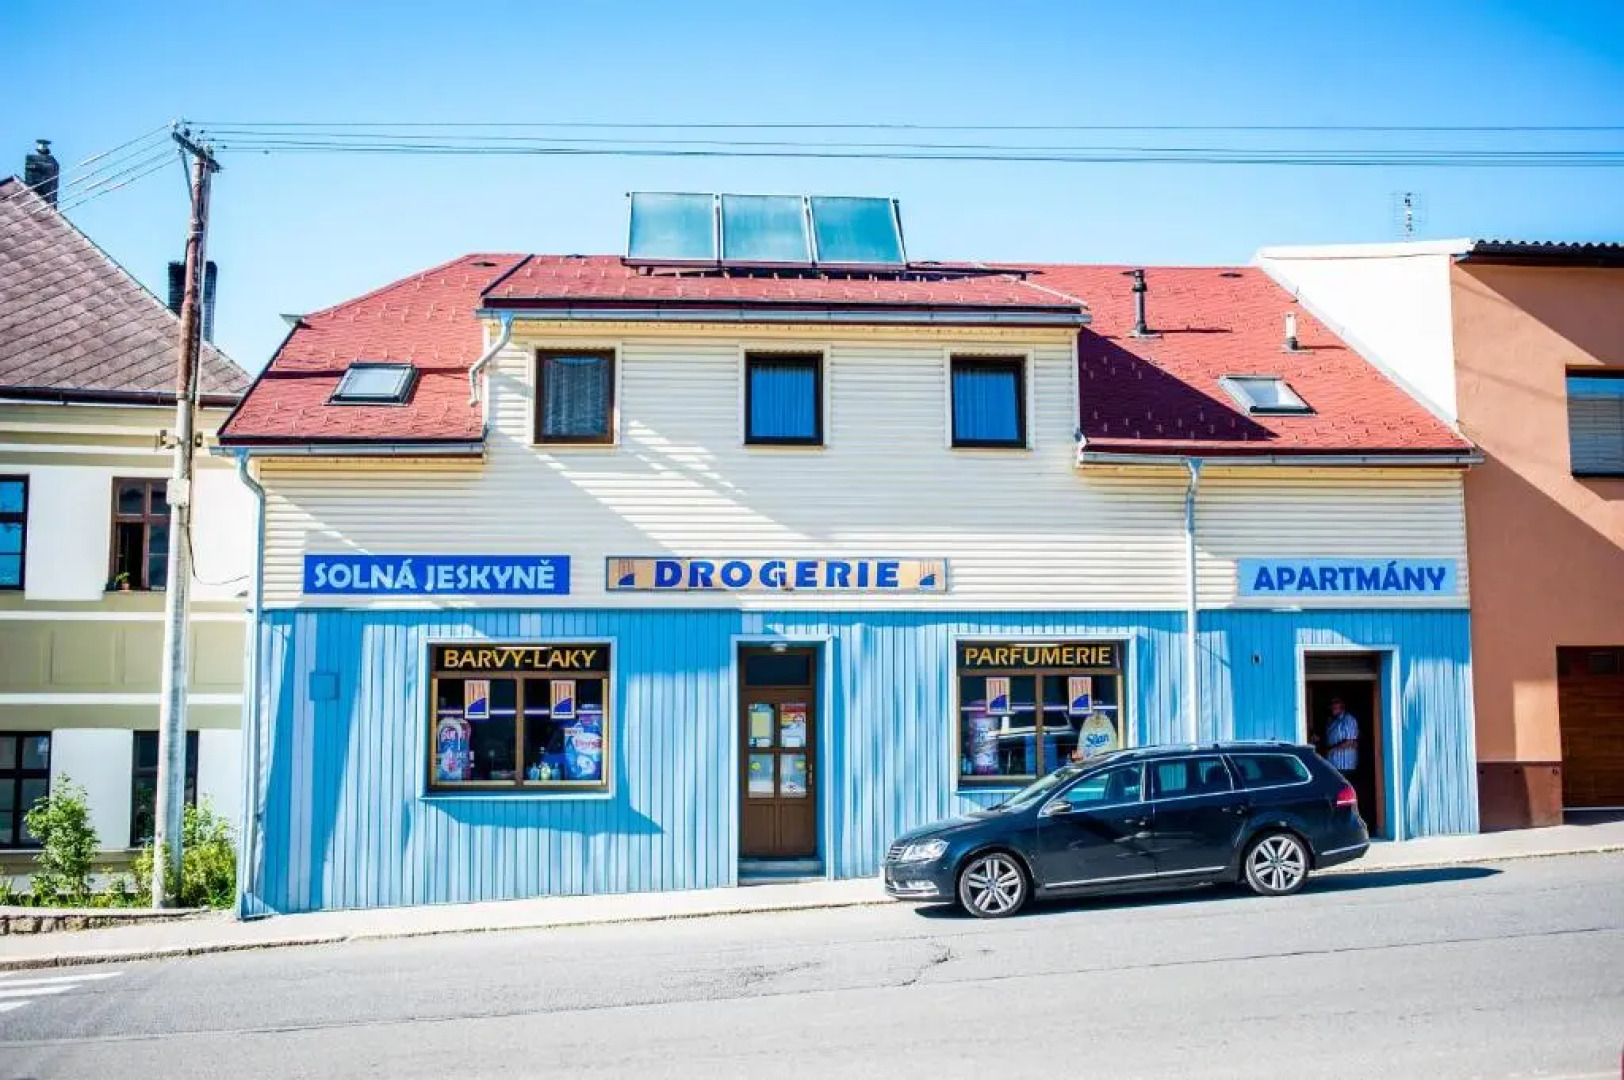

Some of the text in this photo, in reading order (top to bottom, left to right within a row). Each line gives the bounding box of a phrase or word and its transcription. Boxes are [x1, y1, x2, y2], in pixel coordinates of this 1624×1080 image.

[314, 559, 555, 591] SOLNÁ JESKYNĚ
[654, 560, 899, 588] DROGERIE
[1253, 560, 1446, 591] APARTMÁNY
[443, 649, 597, 668] BARVY-LAKY
[965, 646, 1111, 666] PARFUMERIE
